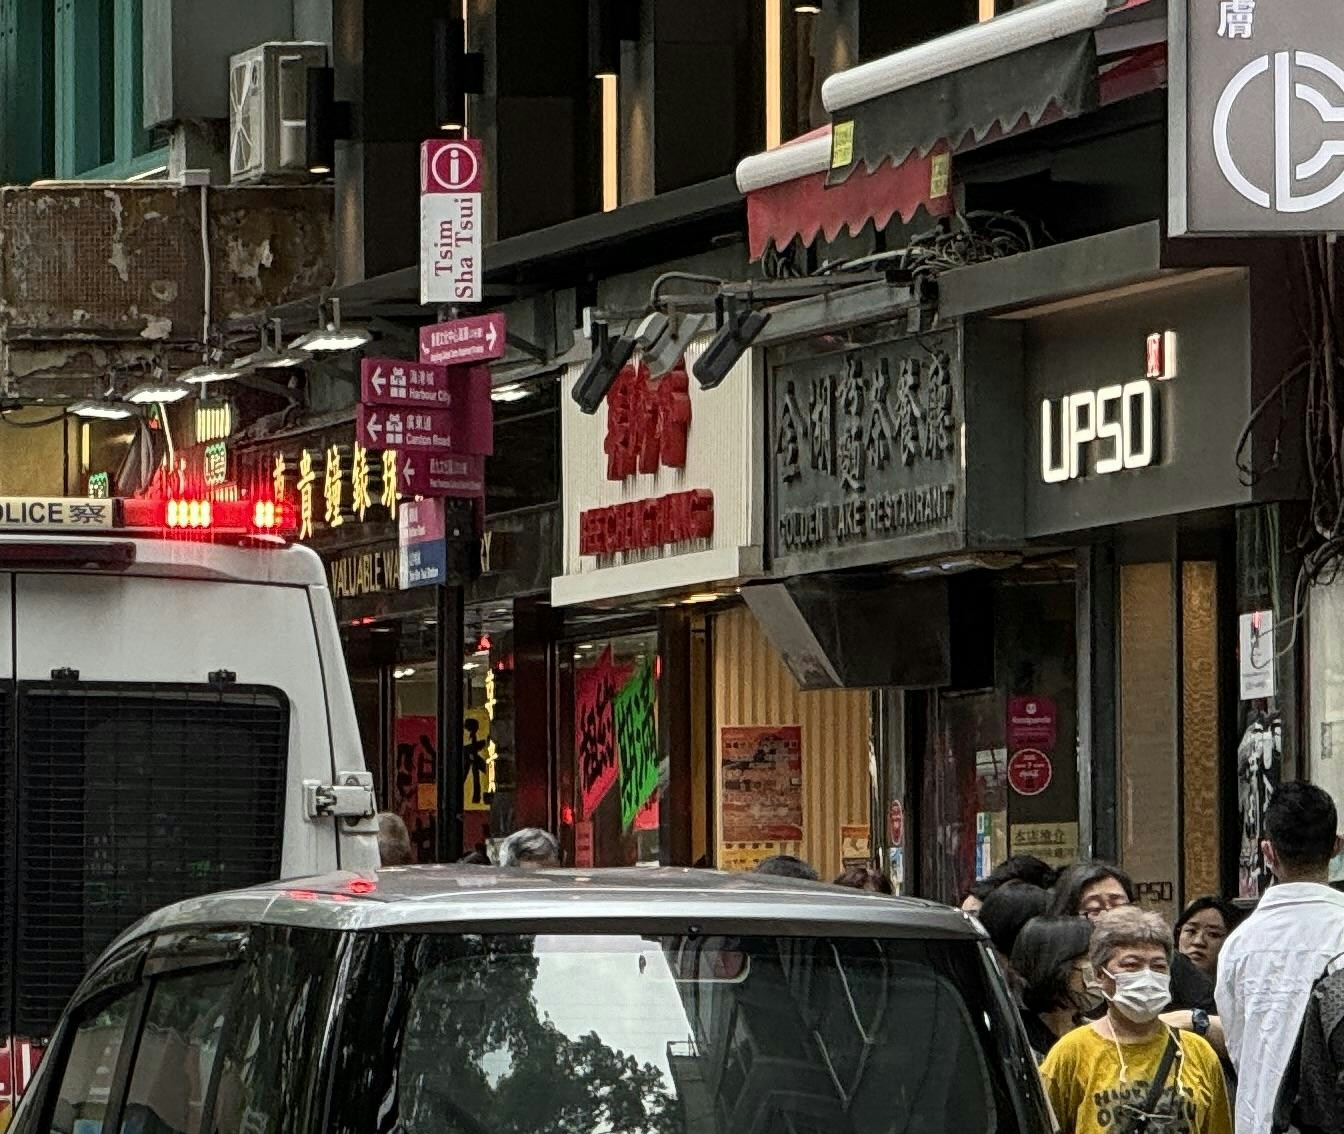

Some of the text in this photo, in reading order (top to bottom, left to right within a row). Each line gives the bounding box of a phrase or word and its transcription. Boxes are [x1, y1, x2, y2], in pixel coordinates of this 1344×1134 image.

[435, 220, 453, 277] Tsim
[455, 197, 474, 299] Sha Tsui
[1042, 378, 1153, 484] UPSO
[70, 503, 106, 524] 察
[331, 555, 380, 597] VALUABLE
